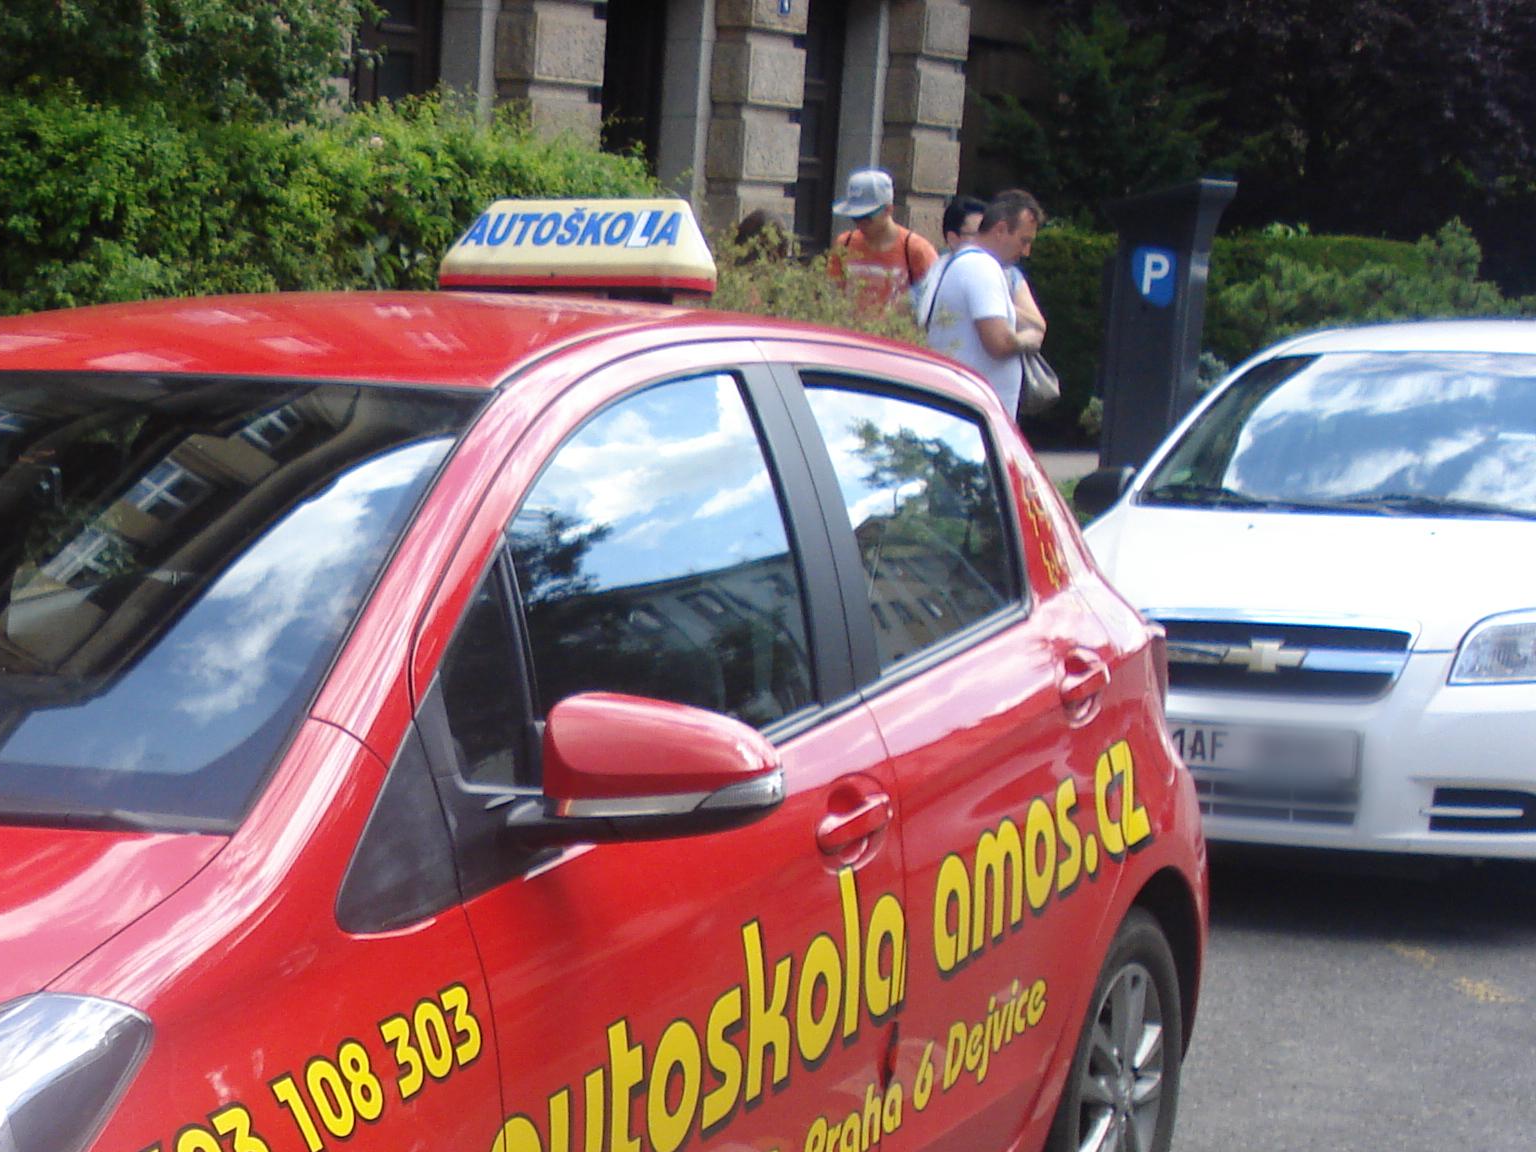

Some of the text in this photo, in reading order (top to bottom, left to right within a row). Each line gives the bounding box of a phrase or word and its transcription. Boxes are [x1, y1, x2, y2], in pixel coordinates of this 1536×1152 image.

[461, 207, 683, 248] AUTOŠKOLA
[1143, 253, 1170, 295] P
[932, 739, 1152, 978] amos.cz
[378, 981, 483, 1101] 303
[912, 1044, 934, 1112] 6
[941, 977, 1048, 1093] Dejvice
